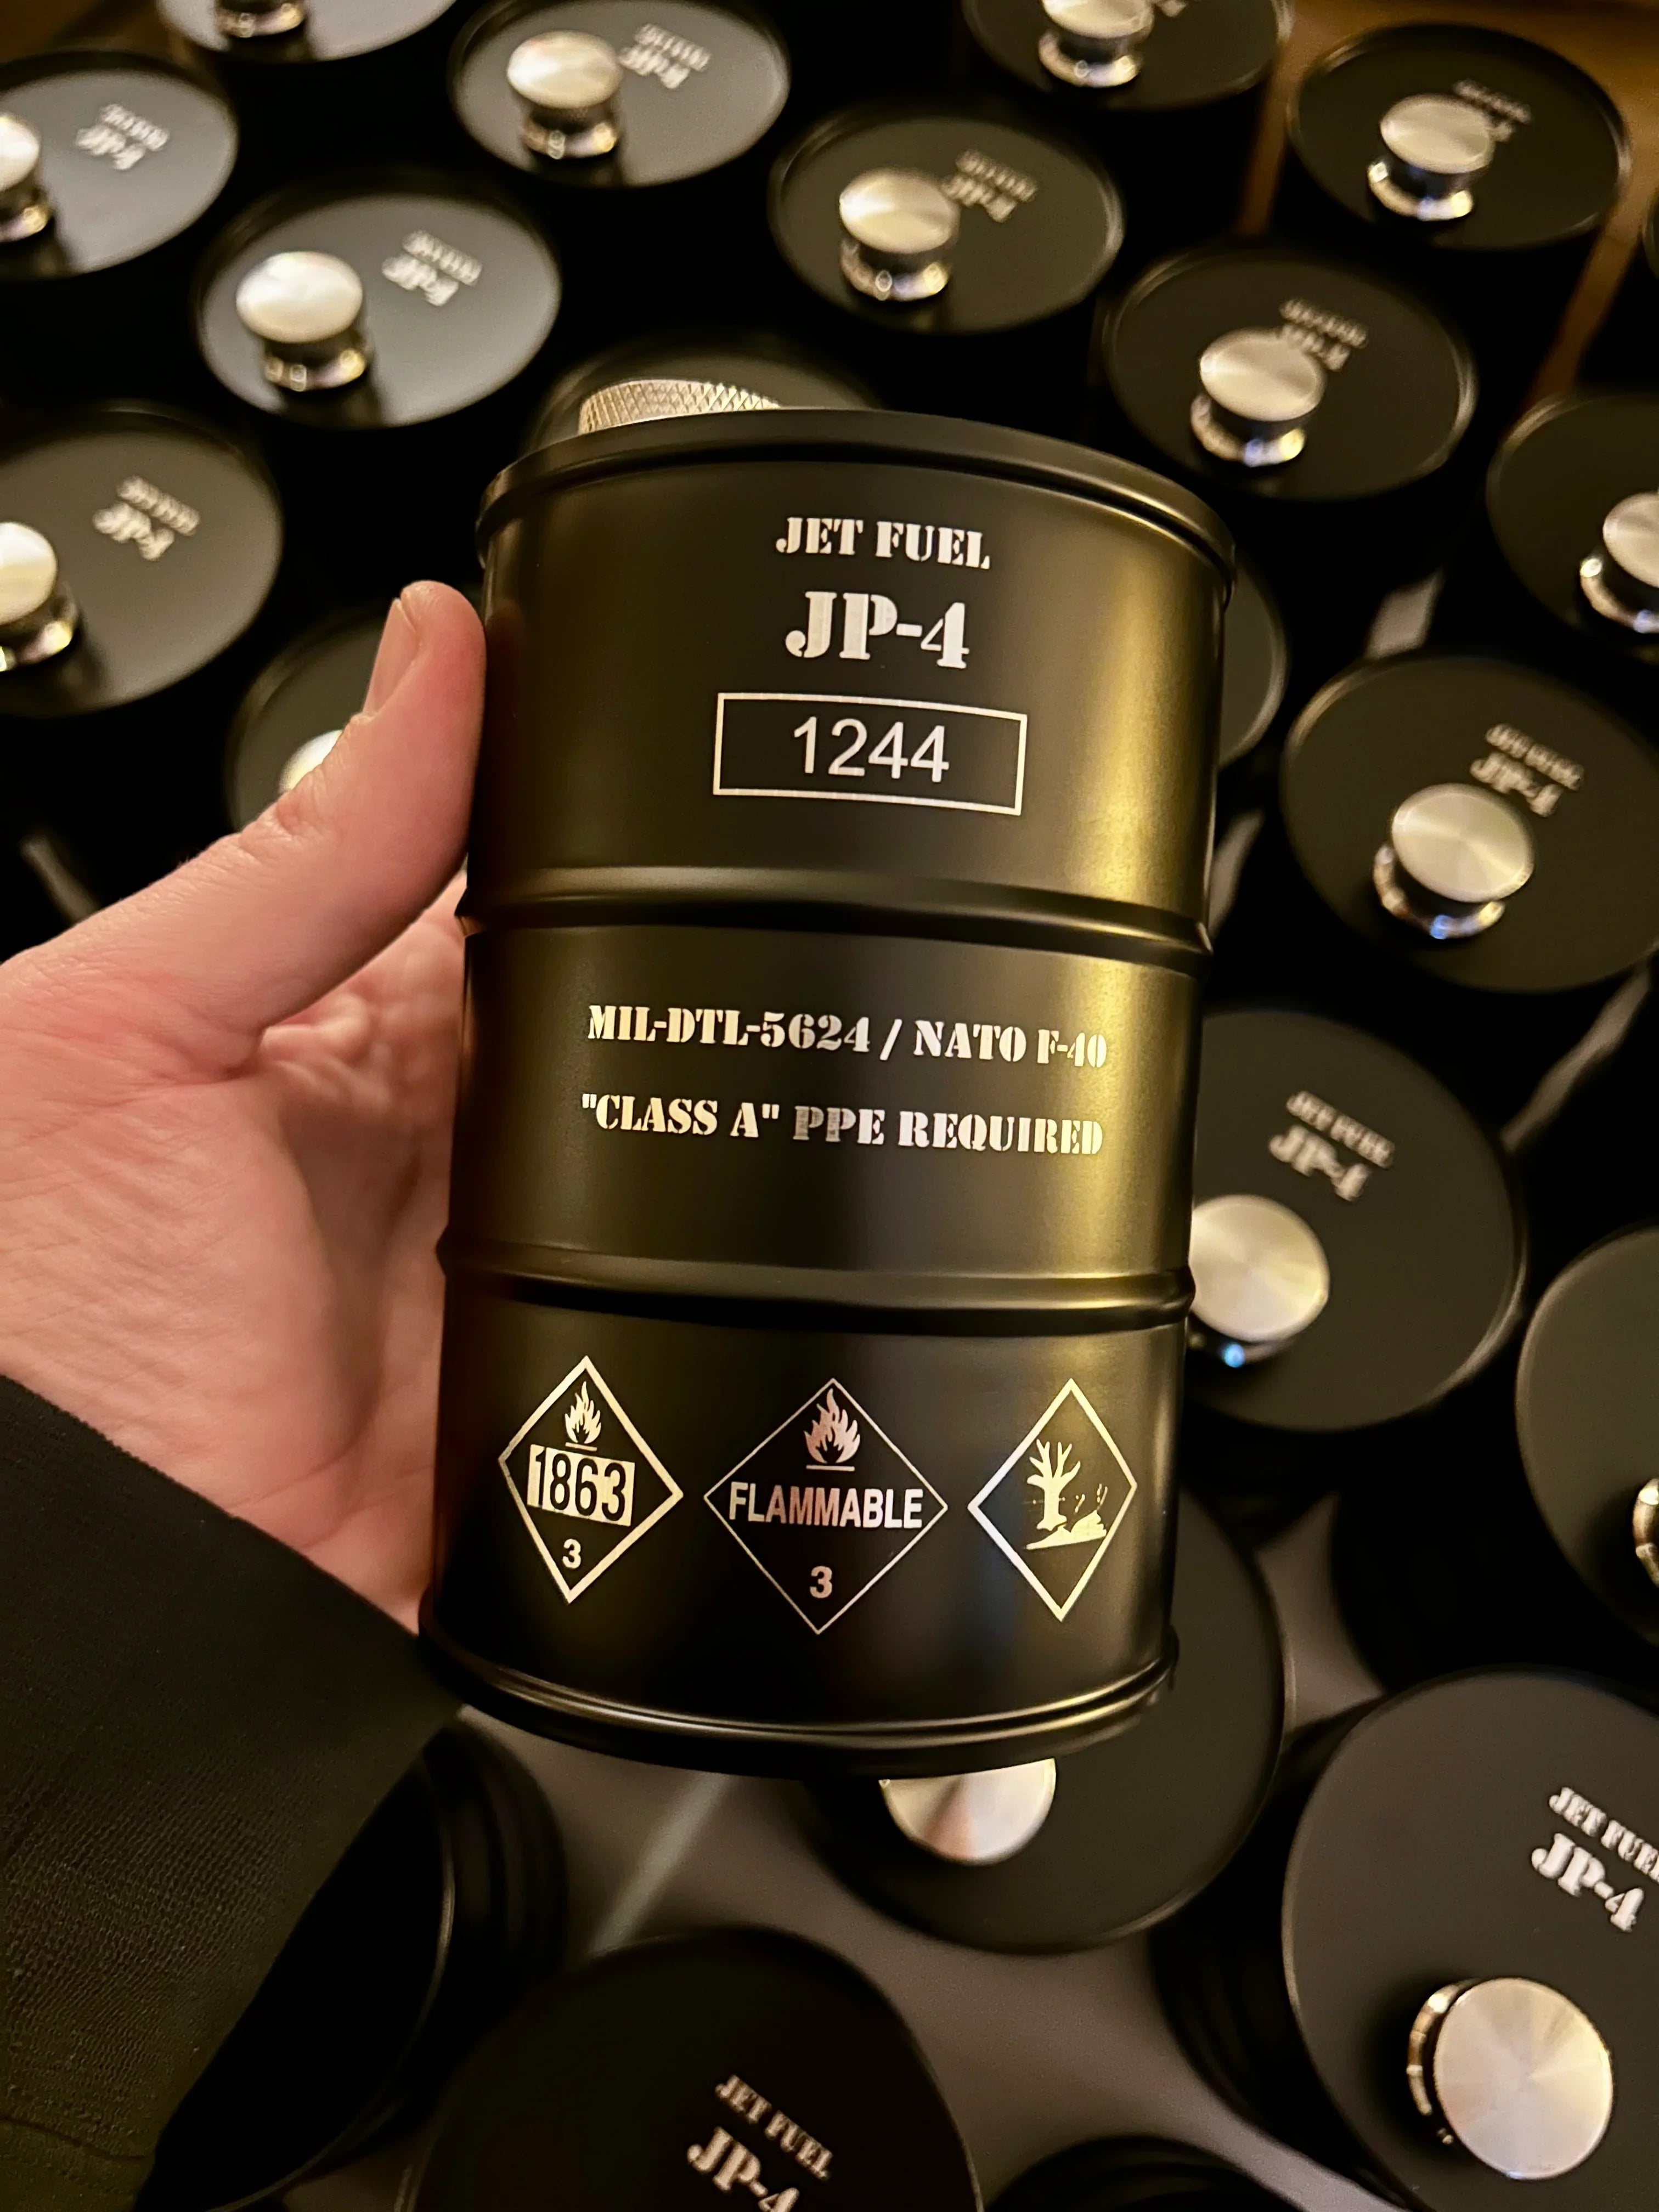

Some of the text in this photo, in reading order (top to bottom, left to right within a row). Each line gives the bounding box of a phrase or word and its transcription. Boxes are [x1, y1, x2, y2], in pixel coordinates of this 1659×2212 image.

[775, 517, 990, 569] JET FUEL
[785, 591, 969, 669] JP-4
[793, 716, 950, 783] 1244
[588, 1005, 1108, 1068] MIL-DTL-5624 / NATO F-40
[582, 1093, 1104, 1155] "CLASS A" PPE REQUIRED
[534, 1448, 626, 1522] 1863
[729, 1481, 923, 1529] FLAMMABLE
[561, 1538, 582, 1569] 3
[809, 1565, 833, 1599] 3
[1549, 1786, 1608, 1837] JET
[1531, 1833, 1644, 1932] JP-4
[715, 2074, 833, 2180] JET FUEL
[686, 2125, 799, 2212] JP-4
